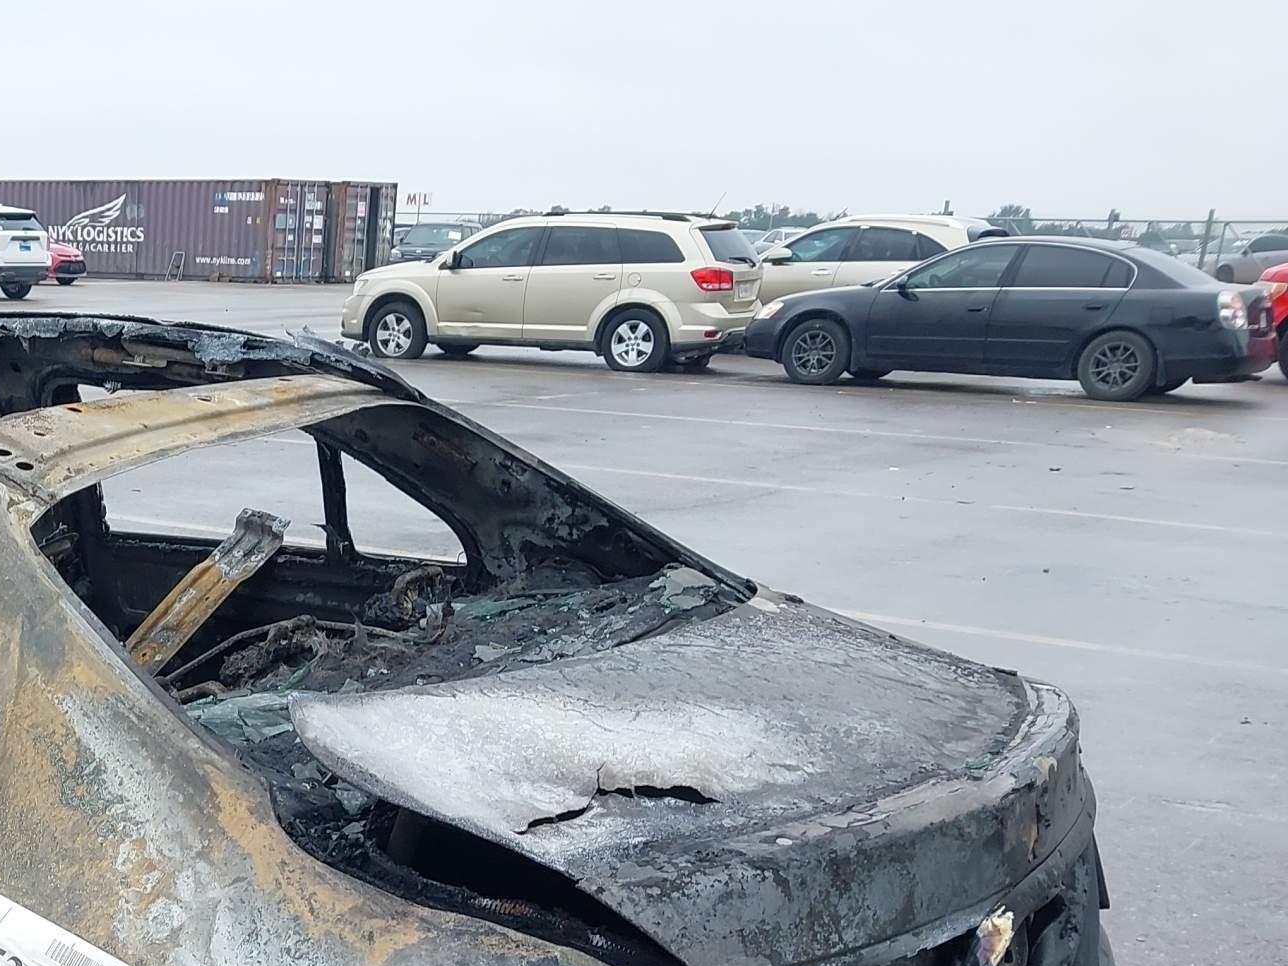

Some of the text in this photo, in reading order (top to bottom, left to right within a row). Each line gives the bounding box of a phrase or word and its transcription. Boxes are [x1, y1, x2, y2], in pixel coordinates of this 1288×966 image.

[406, 194, 417, 206] M
[48, 225, 145, 242] NYK LOGISTICS
